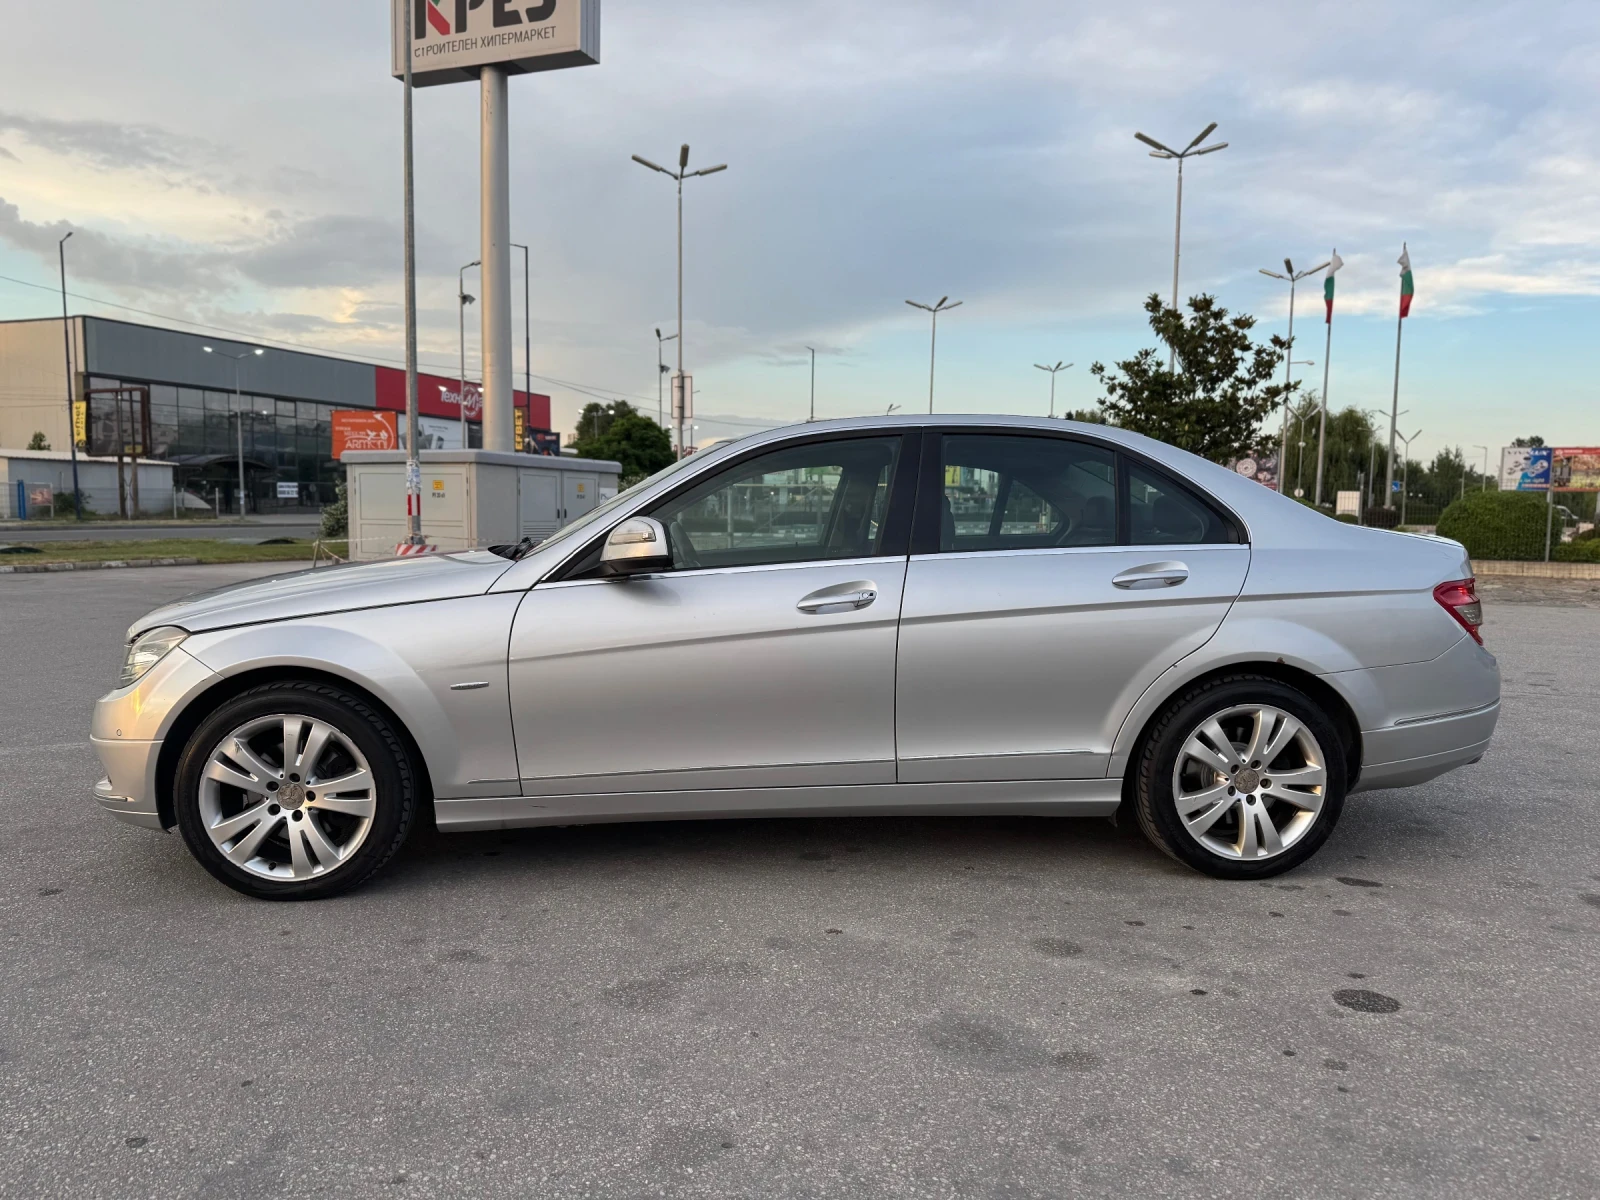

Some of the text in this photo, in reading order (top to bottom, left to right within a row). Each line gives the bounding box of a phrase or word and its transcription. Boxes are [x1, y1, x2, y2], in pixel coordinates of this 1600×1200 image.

[414, 26, 557, 58] СТРОИТЕЛЕН ХИПЕРМАРКЕТ
[514, 408, 523, 450] EFBET
